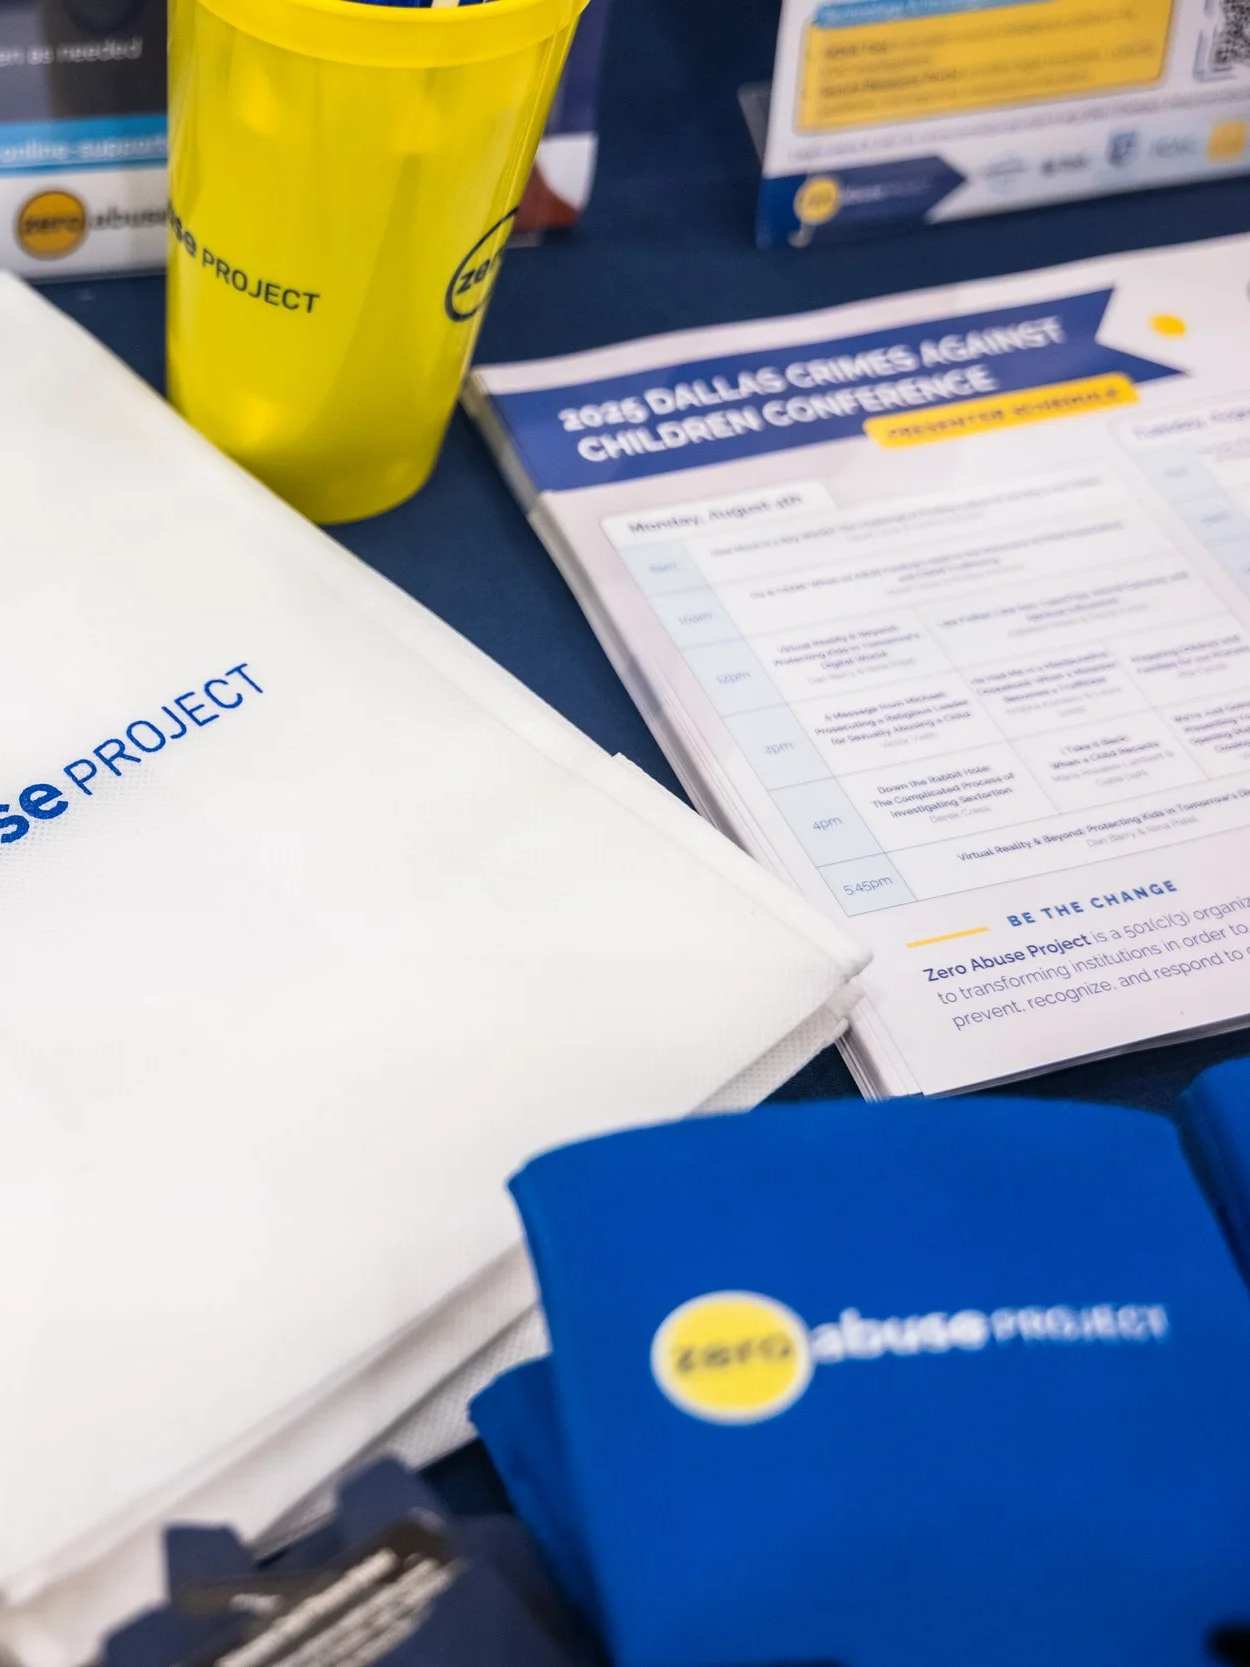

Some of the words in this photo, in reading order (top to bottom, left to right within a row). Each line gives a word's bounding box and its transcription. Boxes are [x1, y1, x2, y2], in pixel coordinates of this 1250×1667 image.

[201, 248, 320, 313] PROJECT
[558, 396, 650, 432] 2025
[643, 366, 788, 415] DALLAS
[784, 344, 920, 389] CRIMES
[918, 315, 1066, 367] AGAINST
[577, 405, 765, 462] CHILDREN
[761, 363, 999, 427] CONFERENCE
[628, 516, 699, 533] Monday,
[708, 501, 769, 519] August
[63, 662, 264, 796] PROJECT
[870, 799, 893, 808] The
[893, 784, 960, 803] Complicated
[961, 776, 1002, 789] Process
[877, 783, 908, 794] Down
[908, 779, 927, 788] the
[927, 770, 962, 783] Rabbit
[890, 799, 958, 817] Investigating
[958, 787, 1012, 803] Sextortion
[812, 817, 842, 830] 4pm
[957, 847, 994, 861] Virtual
[995, 841, 1031, 853] Reality
[1042, 828, 1084, 843] Beyond:
[1086, 816, 1141, 832] Protecting
[1141, 810, 1164, 821] Kids
[843, 876, 892, 895] 5:45pm
[1006, 911, 1035, 927] BE
[1040, 901, 1083, 919] THE
[1090, 880, 1176, 908] CHANGE
[922, 964, 966, 981] Zero
[970, 951, 1025, 971] Abuse
[1026, 934, 1091, 957] Project
[1089, 931, 1108, 943] is
[1109, 929, 1122, 940] a
[1123, 911, 1190, 938] 501(c)(3)
[937, 991, 958, 1004] to
[959, 965, 1070, 999] transforming
[1070, 944, 1161, 972] institutions
[1161, 939, 1181, 952] in
[1182, 928, 1226, 947] order
[1228, 923, 1250, 936] to
[952, 1000, 1024, 1030] prevent,
[1027, 980, 1116, 1007] recognize,
[1117, 968, 1152, 987] and
[1153, 952, 1223, 978] respond
[1223, 949, 1244, 962] to
[672, 1331, 793, 1375] zero
[810, 1306, 989, 1363] abuse
[988, 1304, 1170, 1347] PROJECT
